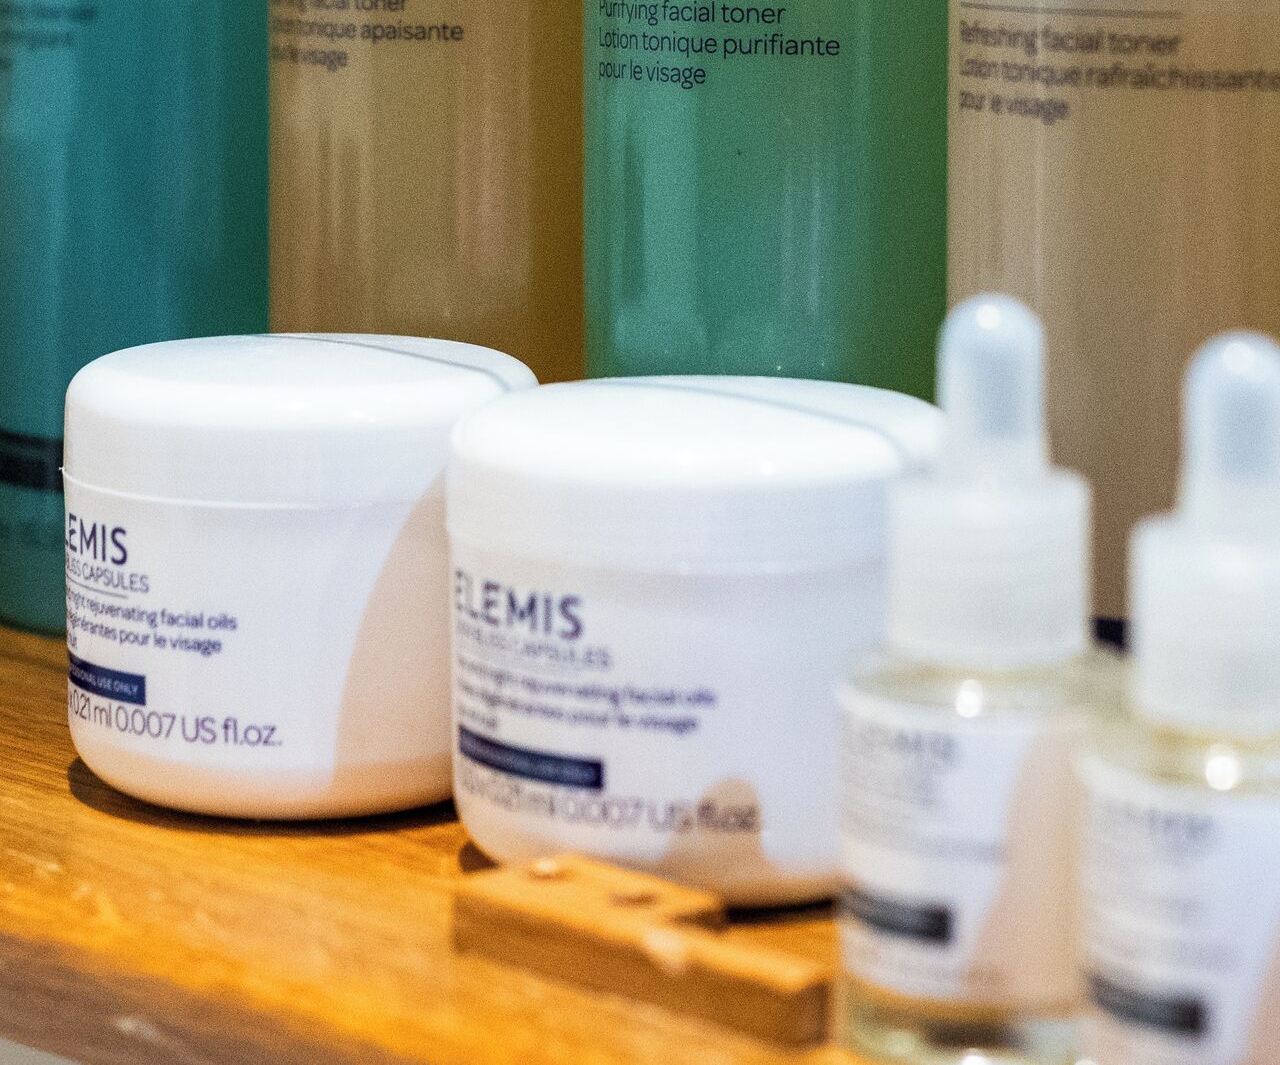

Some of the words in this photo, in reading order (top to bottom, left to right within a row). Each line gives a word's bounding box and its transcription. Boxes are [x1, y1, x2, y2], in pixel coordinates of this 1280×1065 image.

[661, 0, 716, 23] facial
[721, 3, 787, 24] toner
[360, 20, 465, 44] apaisante
[599, 27, 639, 51] Lotion
[642, 30, 718, 59] tonique
[723, 32, 841, 60] purifiante
[1041, 24, 1106, 55] facial
[1108, 31, 1181, 56] toner
[599, 60, 627, 82] pour
[629, 58, 643, 82] le
[645, 60, 707, 90] visage
[65, 512, 129, 566] EMIS
[81, 561, 150, 595] CAPSULES
[85, 596, 159, 630] rejuvenating
[160, 607, 205, 630] facial
[206, 613, 239, 632] oils
[118, 628, 151, 648] pour
[153, 630, 167, 650] le
[169, 636, 224, 660] visage
[93, 701, 114, 731] ml
[115, 705, 178, 741] 0.007
[180, 714, 217, 745] US
